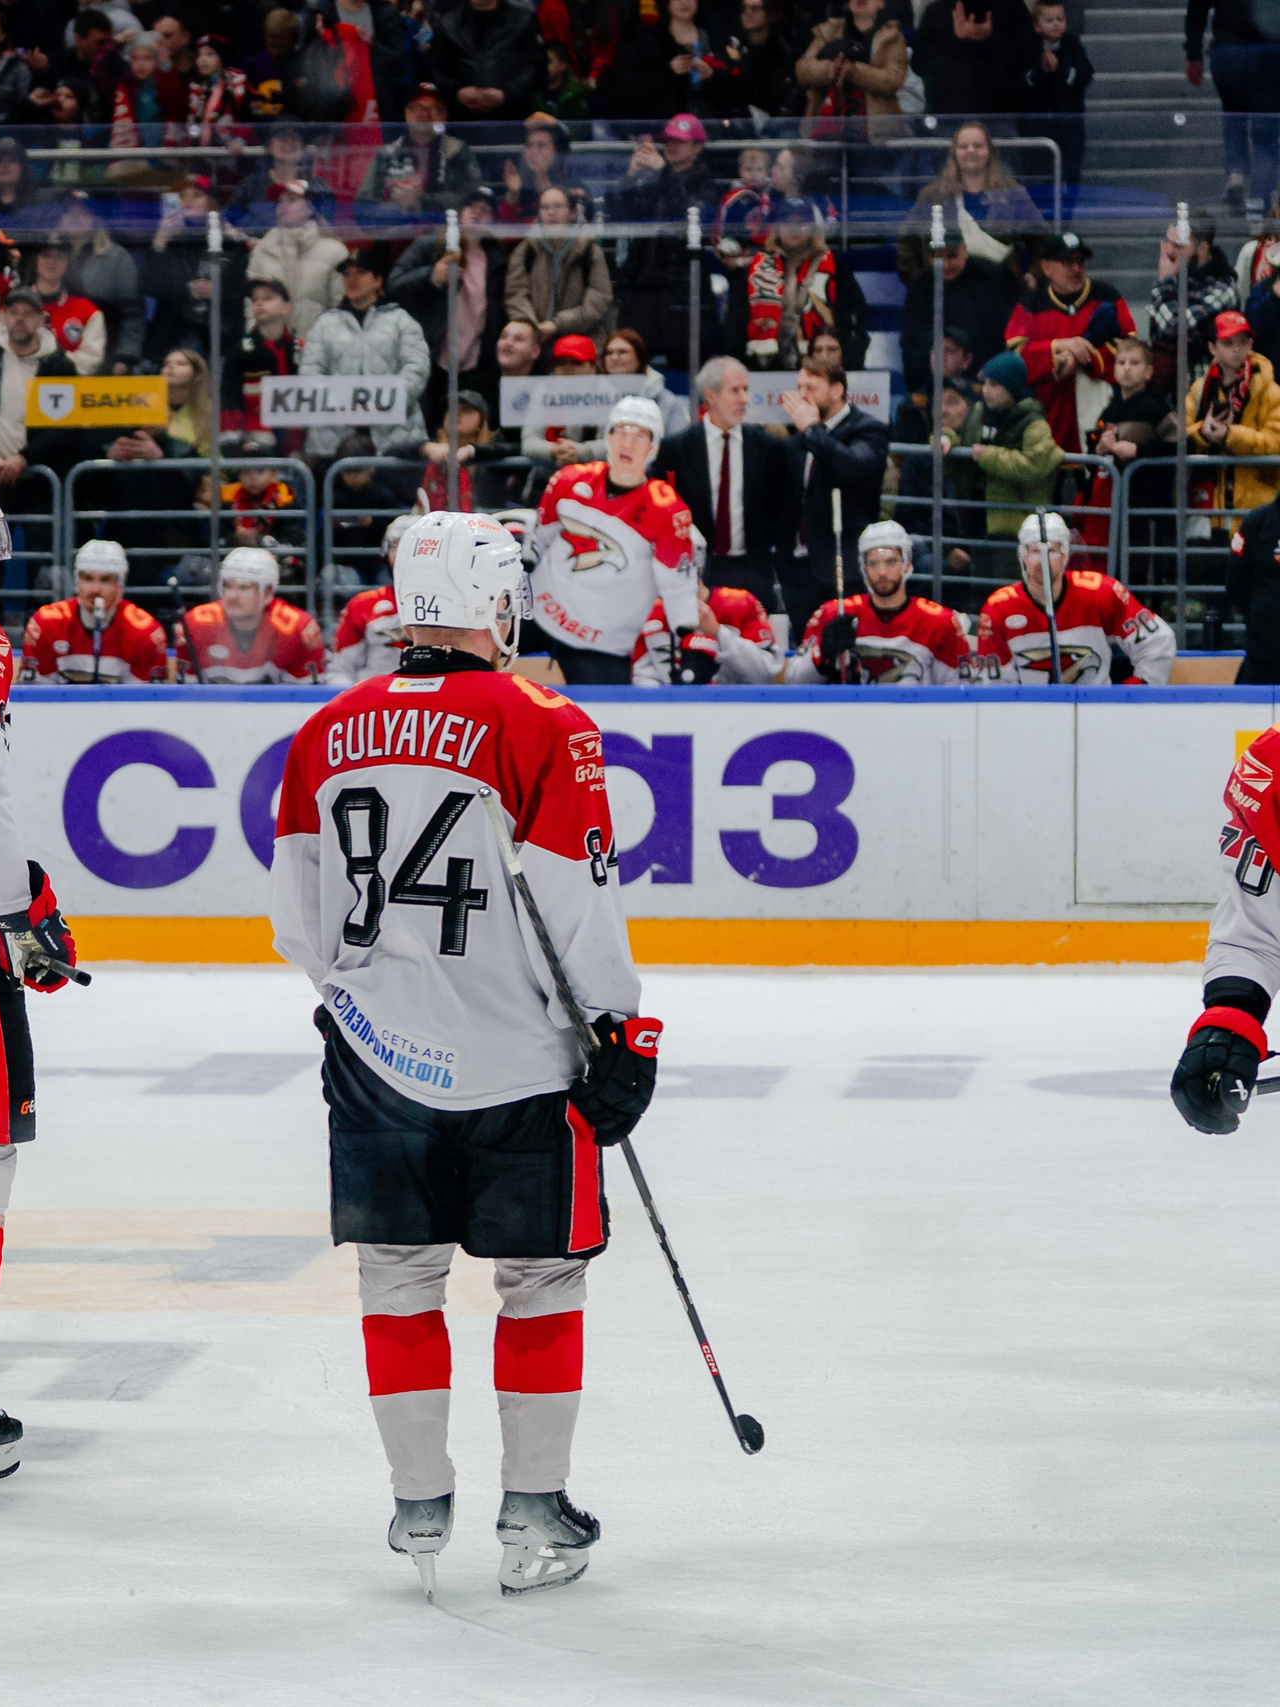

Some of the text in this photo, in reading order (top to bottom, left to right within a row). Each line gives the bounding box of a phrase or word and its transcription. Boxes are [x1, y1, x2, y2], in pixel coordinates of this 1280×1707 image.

[80, 394, 151, 409] БАНК
[270, 387, 397, 413] KHL.RU
[542, 393, 639, 407] ГАЗПРОМБ
[417, 547, 437, 555] BET
[414, 595, 441, 622] 84
[535, 591, 603, 644] FONBET
[327, 708, 489, 769] GULYAYEV
[63, 727, 859, 890] саз
[331, 786, 489, 957] 84
[381, 1029, 455, 1064] СЕТЬ АЗС
[703, 1344, 718, 1374] CCM
[560, 1514, 588, 1538] BAUER
